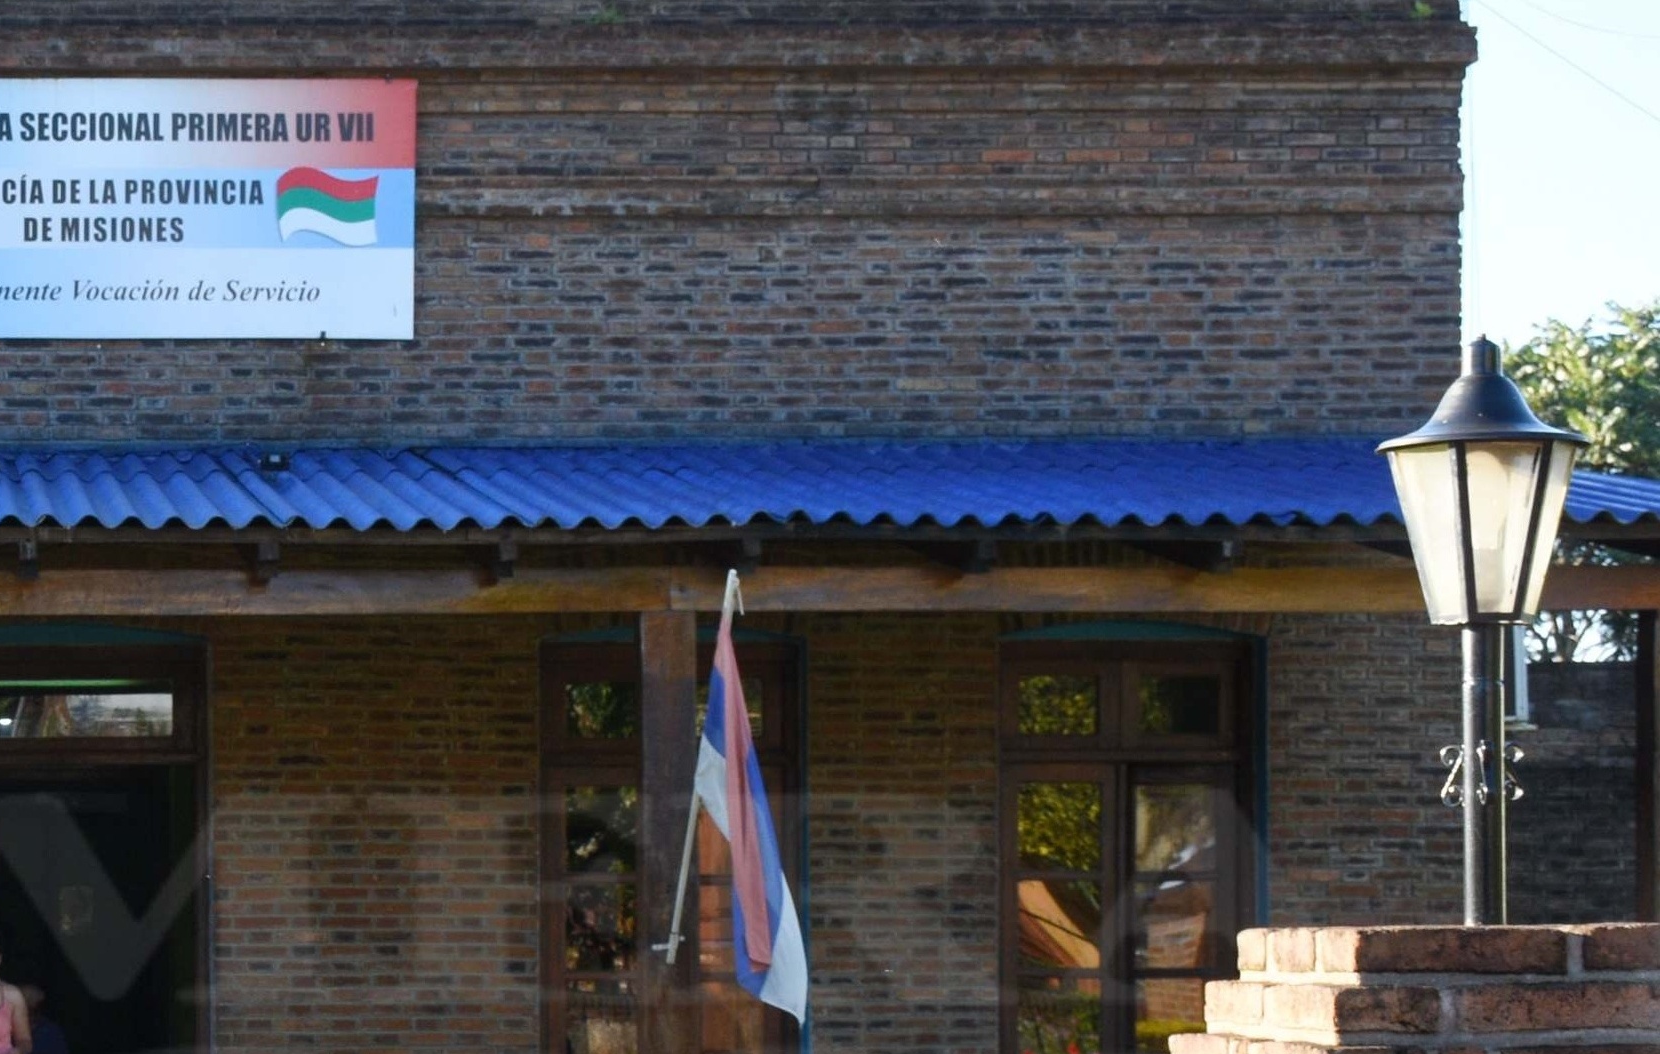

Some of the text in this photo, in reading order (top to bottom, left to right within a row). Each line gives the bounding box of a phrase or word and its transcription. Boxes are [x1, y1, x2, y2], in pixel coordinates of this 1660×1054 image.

[20, 111, 164, 142] SECCIONAL
[171, 111, 289, 142] PRIMERA
[295, 111, 331, 142] UR
[337, 111, 375, 142] VII
[52, 179, 81, 204] DE
[88, 179, 117, 204] LA
[125, 179, 265, 205] PROVINCIA
[23, 216, 185, 243] DE MISIONES
[72, 279, 179, 302] Vocación
[187, 279, 217, 302] de
[222, 278, 321, 303] Servicio
